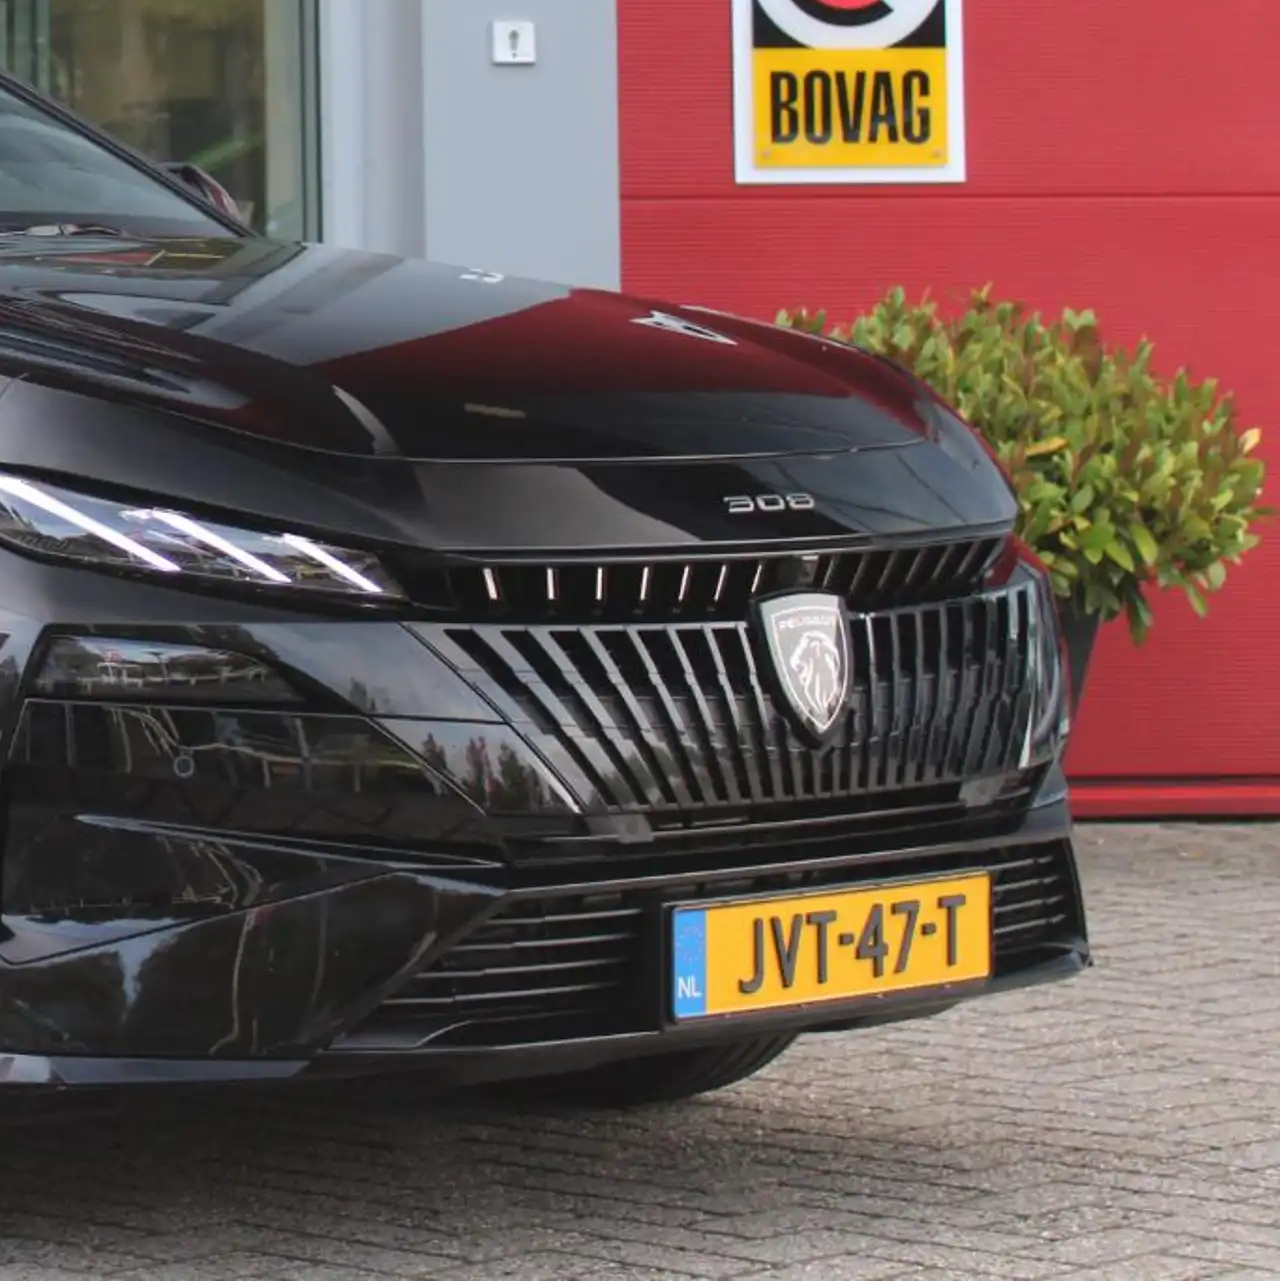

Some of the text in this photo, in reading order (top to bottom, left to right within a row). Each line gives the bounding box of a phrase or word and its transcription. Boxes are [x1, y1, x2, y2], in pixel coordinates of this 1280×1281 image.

[769, 69, 931, 146] BOVAG
[723, 493, 815, 513] 308
[737, 893, 967, 995] JVT-47-T
[677, 975, 702, 998] NL
